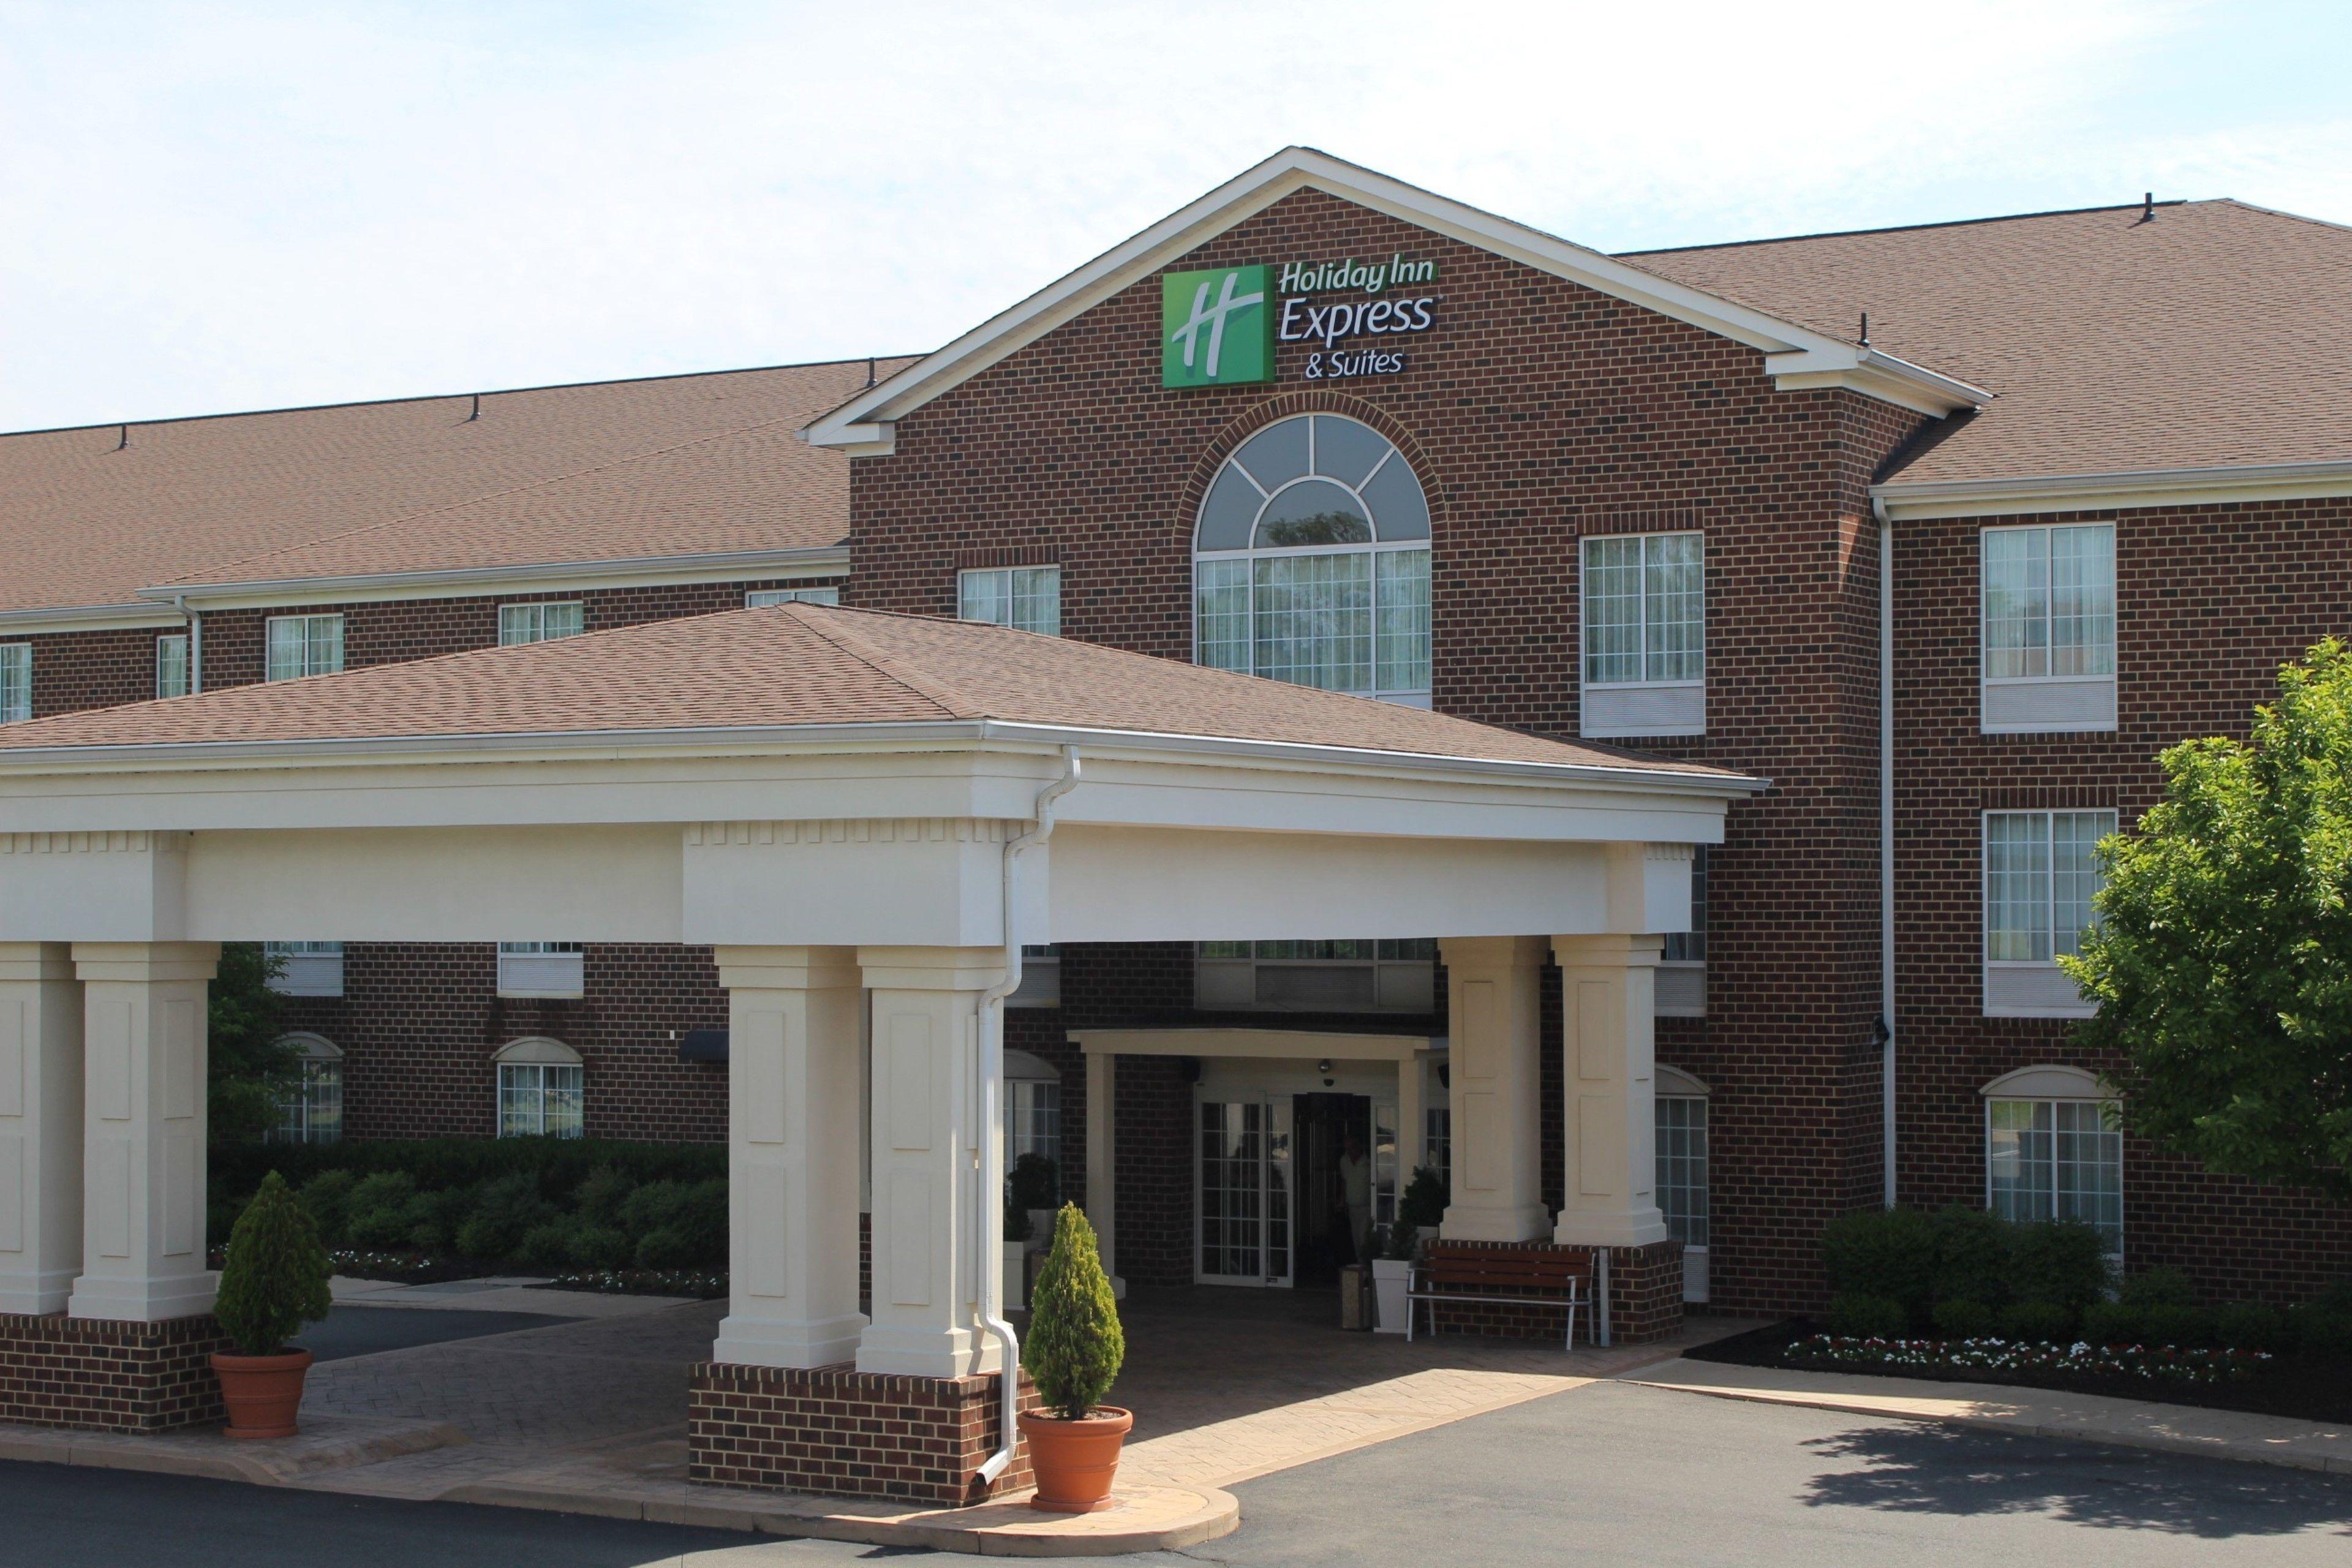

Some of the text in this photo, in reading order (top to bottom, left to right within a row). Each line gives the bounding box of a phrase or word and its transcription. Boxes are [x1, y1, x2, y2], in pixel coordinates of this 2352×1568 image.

[1278, 254, 1433, 293] Holiday Inn
[1281, 298, 1433, 349] Express
[1305, 350, 1403, 379] & Suites
